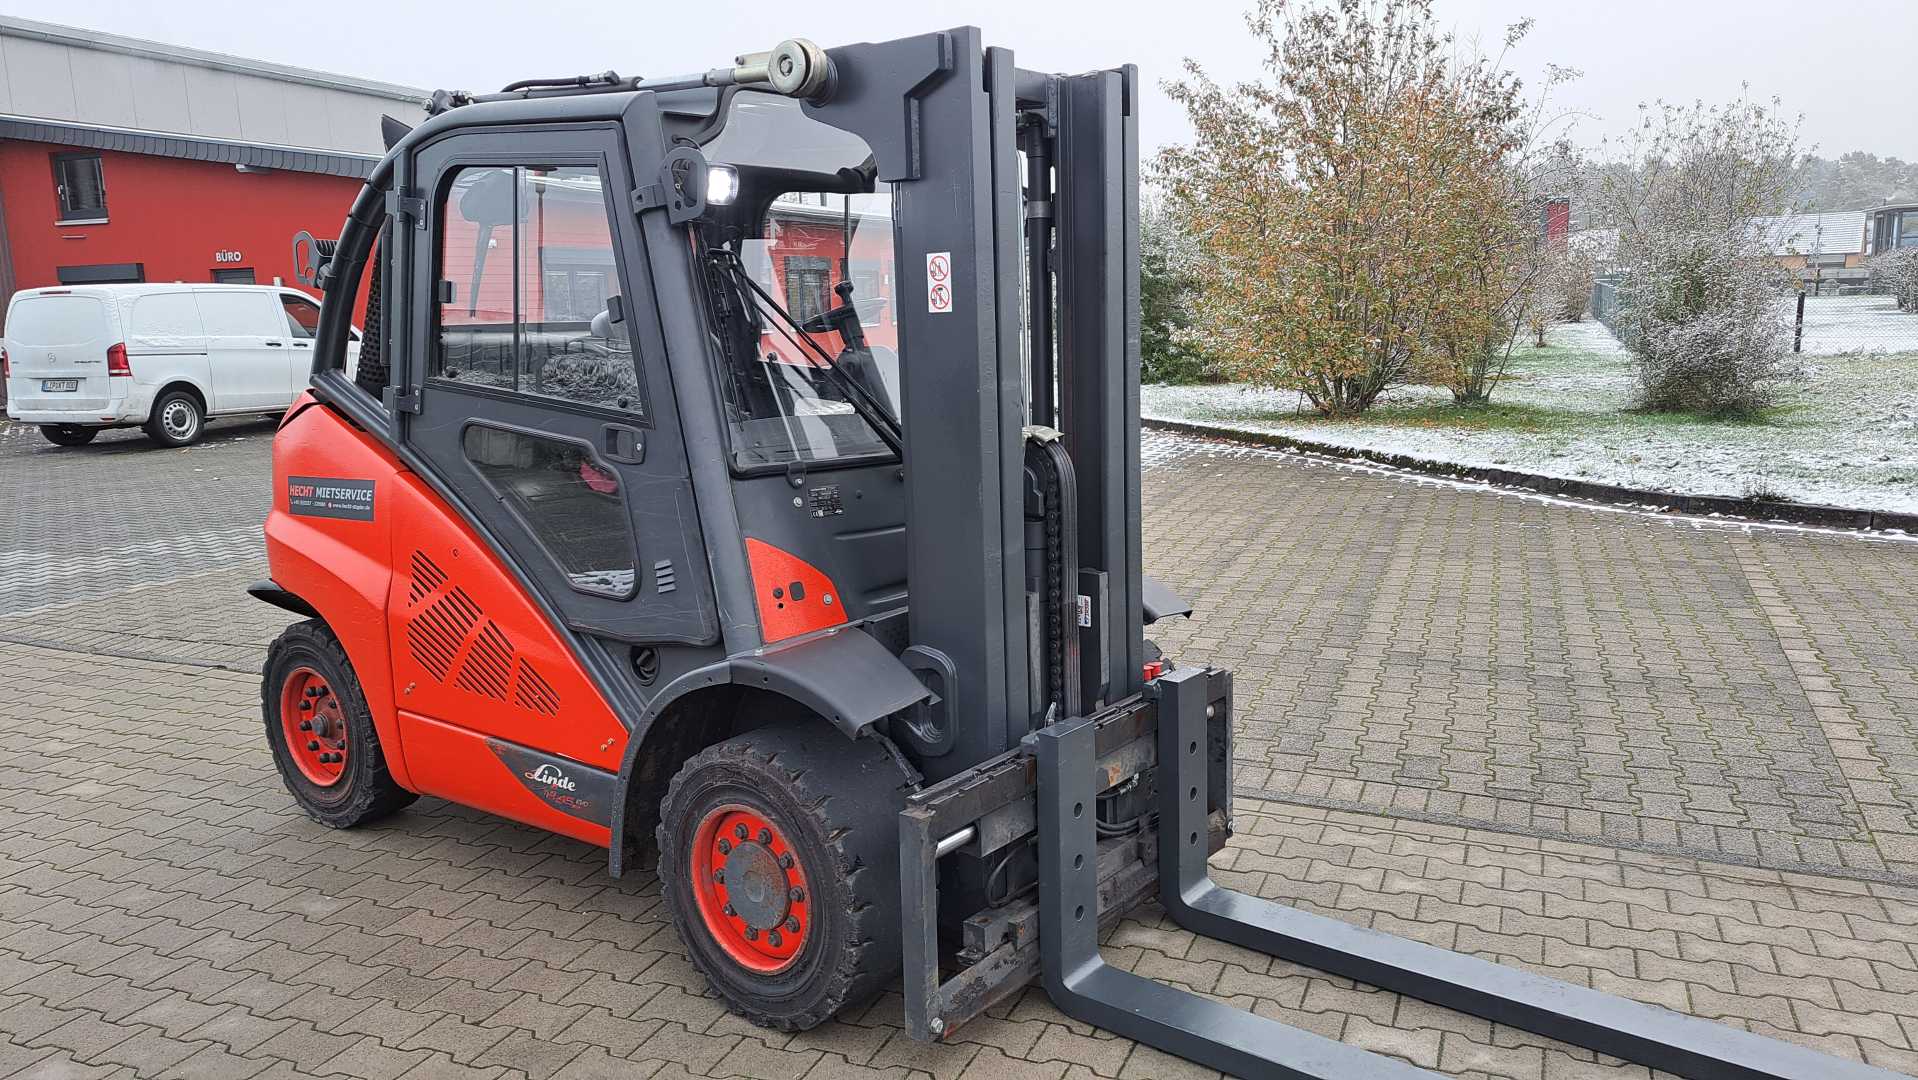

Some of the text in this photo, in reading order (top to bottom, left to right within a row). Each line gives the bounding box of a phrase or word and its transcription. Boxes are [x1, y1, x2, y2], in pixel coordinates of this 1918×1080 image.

[216, 249, 241, 262] BÜRO
[289, 485, 372, 501] HECHT MIETSERVICE
[525, 764, 576, 791] Linde
